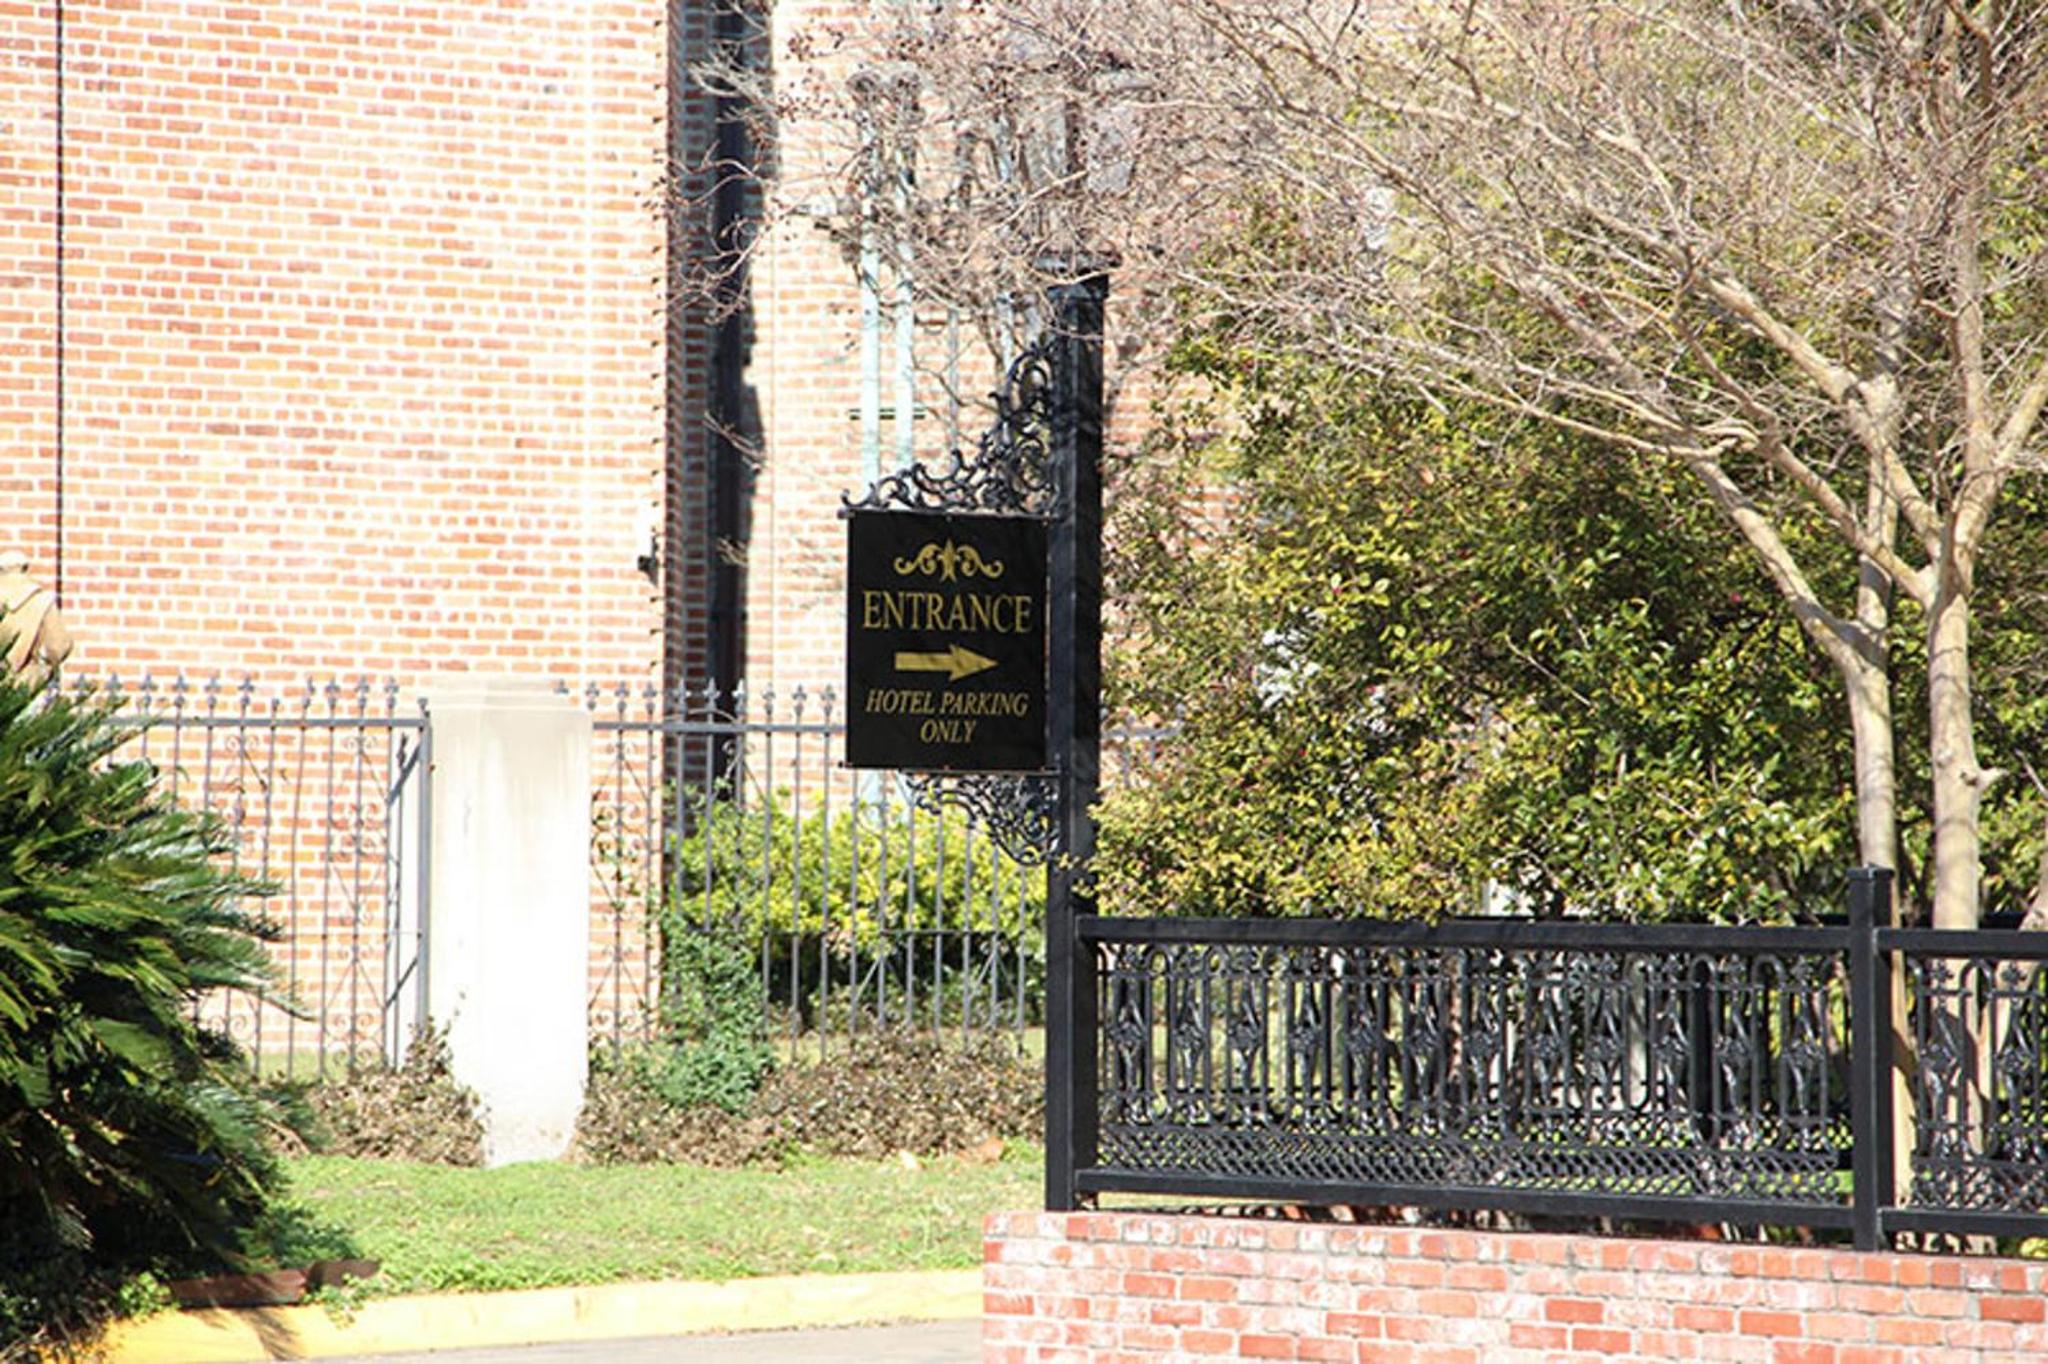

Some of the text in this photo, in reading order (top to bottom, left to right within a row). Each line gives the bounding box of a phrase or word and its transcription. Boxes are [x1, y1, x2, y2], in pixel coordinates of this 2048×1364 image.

[862, 590, 1033, 633] ENTRANCE
[865, 689, 1029, 717] HOTEL PARKING
[920, 719, 976, 743] ONLY
